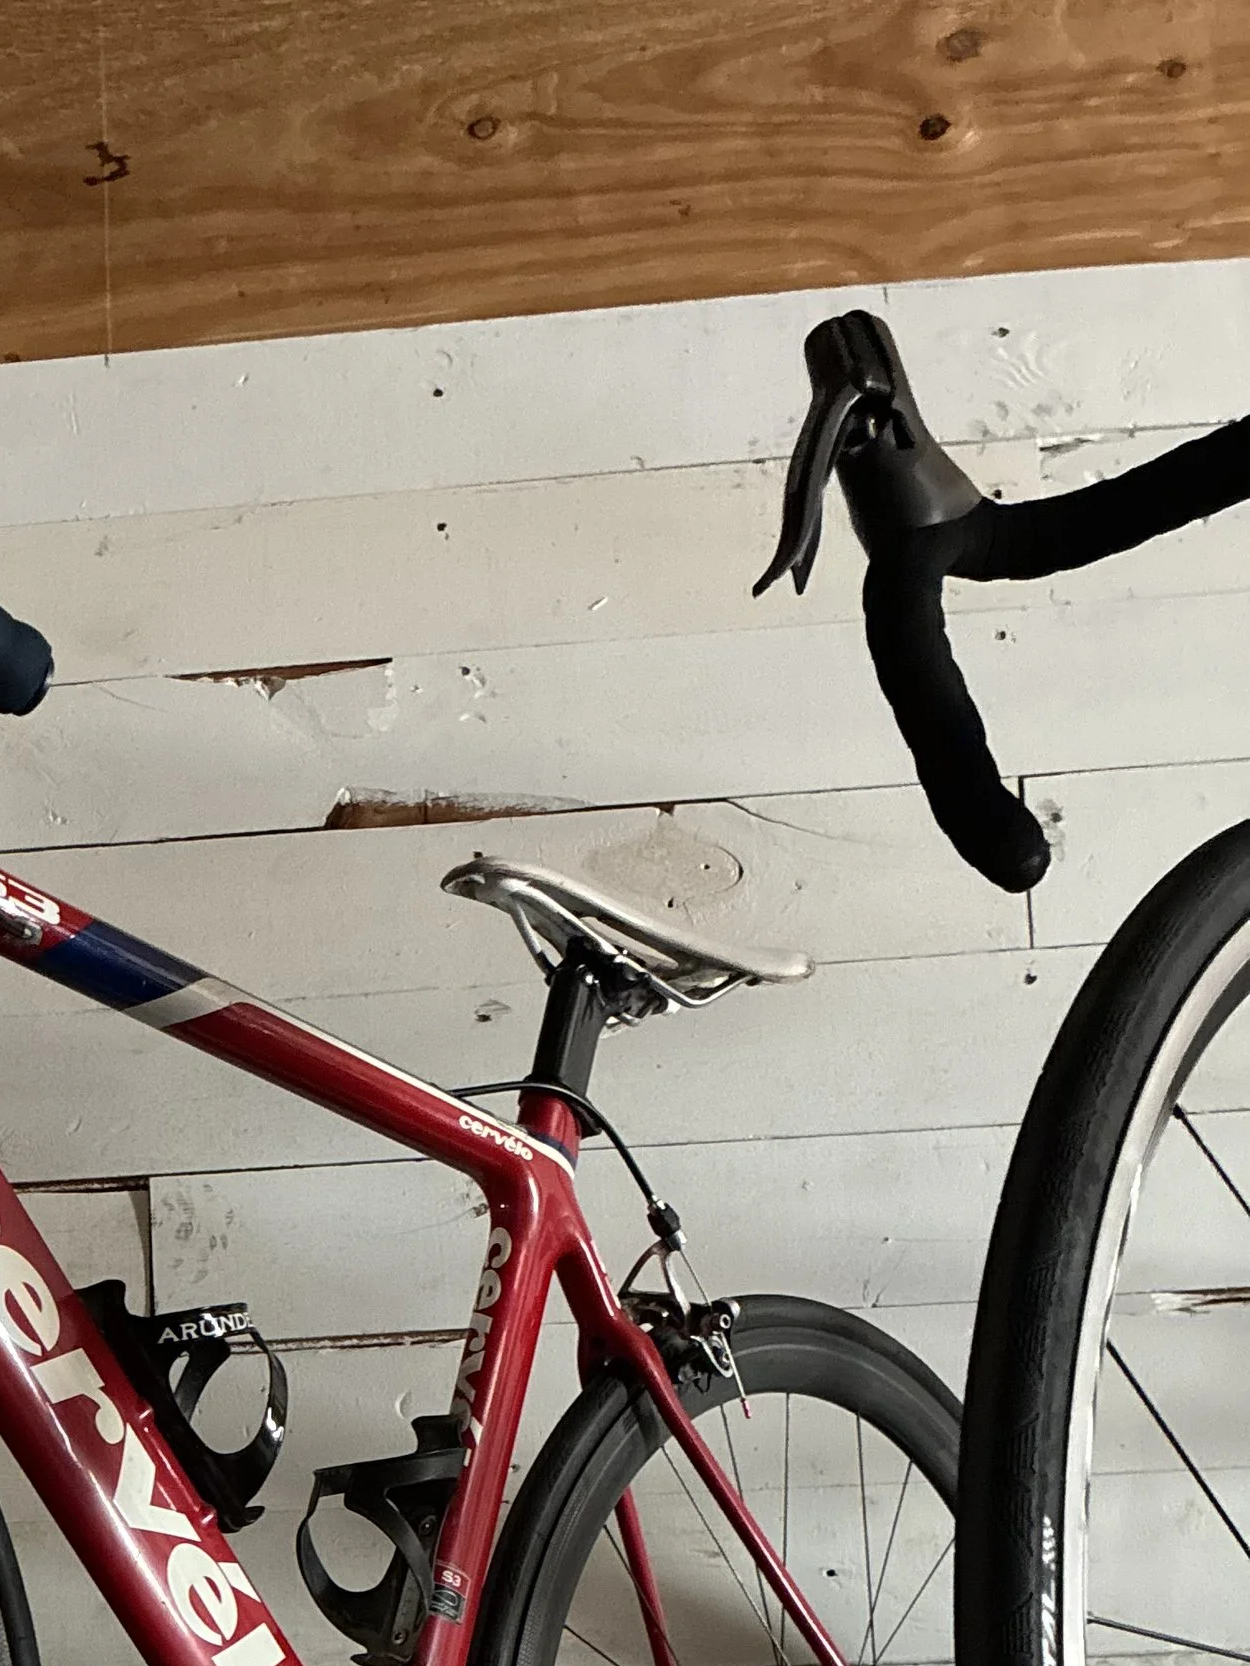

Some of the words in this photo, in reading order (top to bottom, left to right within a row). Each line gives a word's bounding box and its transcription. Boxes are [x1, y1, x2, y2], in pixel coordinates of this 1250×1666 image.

[458, 1113, 533, 1163] cervélo
[157, 1310, 255, 1346] ARUNDE
[441, 1567, 463, 1588] S3
